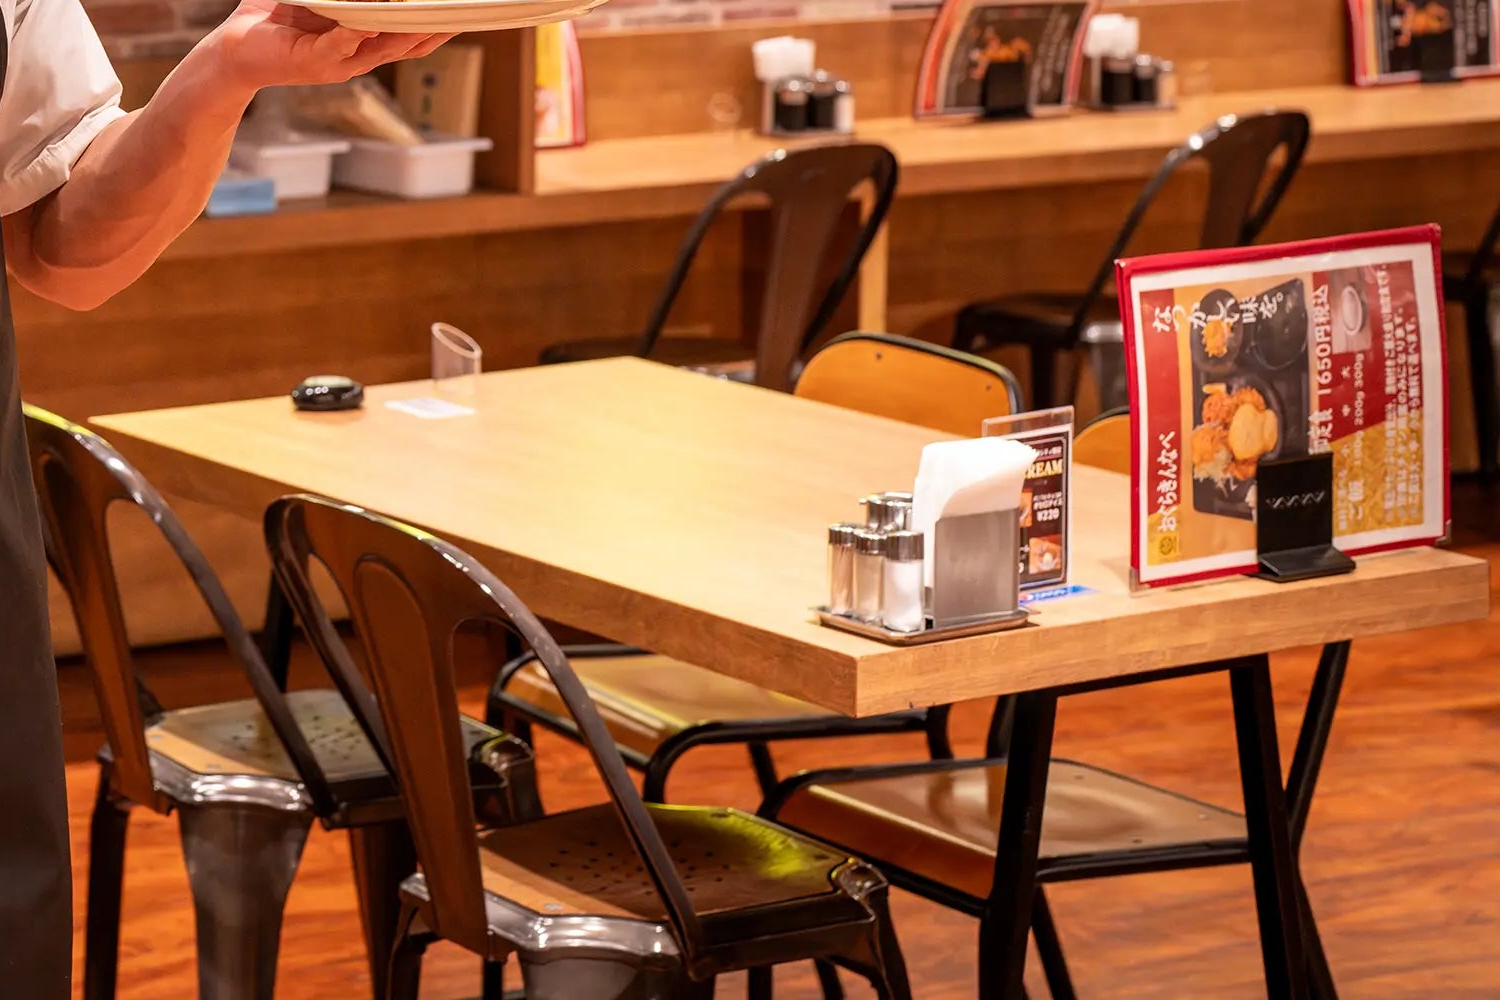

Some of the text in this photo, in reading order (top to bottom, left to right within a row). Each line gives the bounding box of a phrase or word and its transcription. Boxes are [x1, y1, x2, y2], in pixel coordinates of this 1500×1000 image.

[1151, 291, 1284, 334] なつかしい味を。
[1156, 430, 1179, 533] おぐらきんなべ
